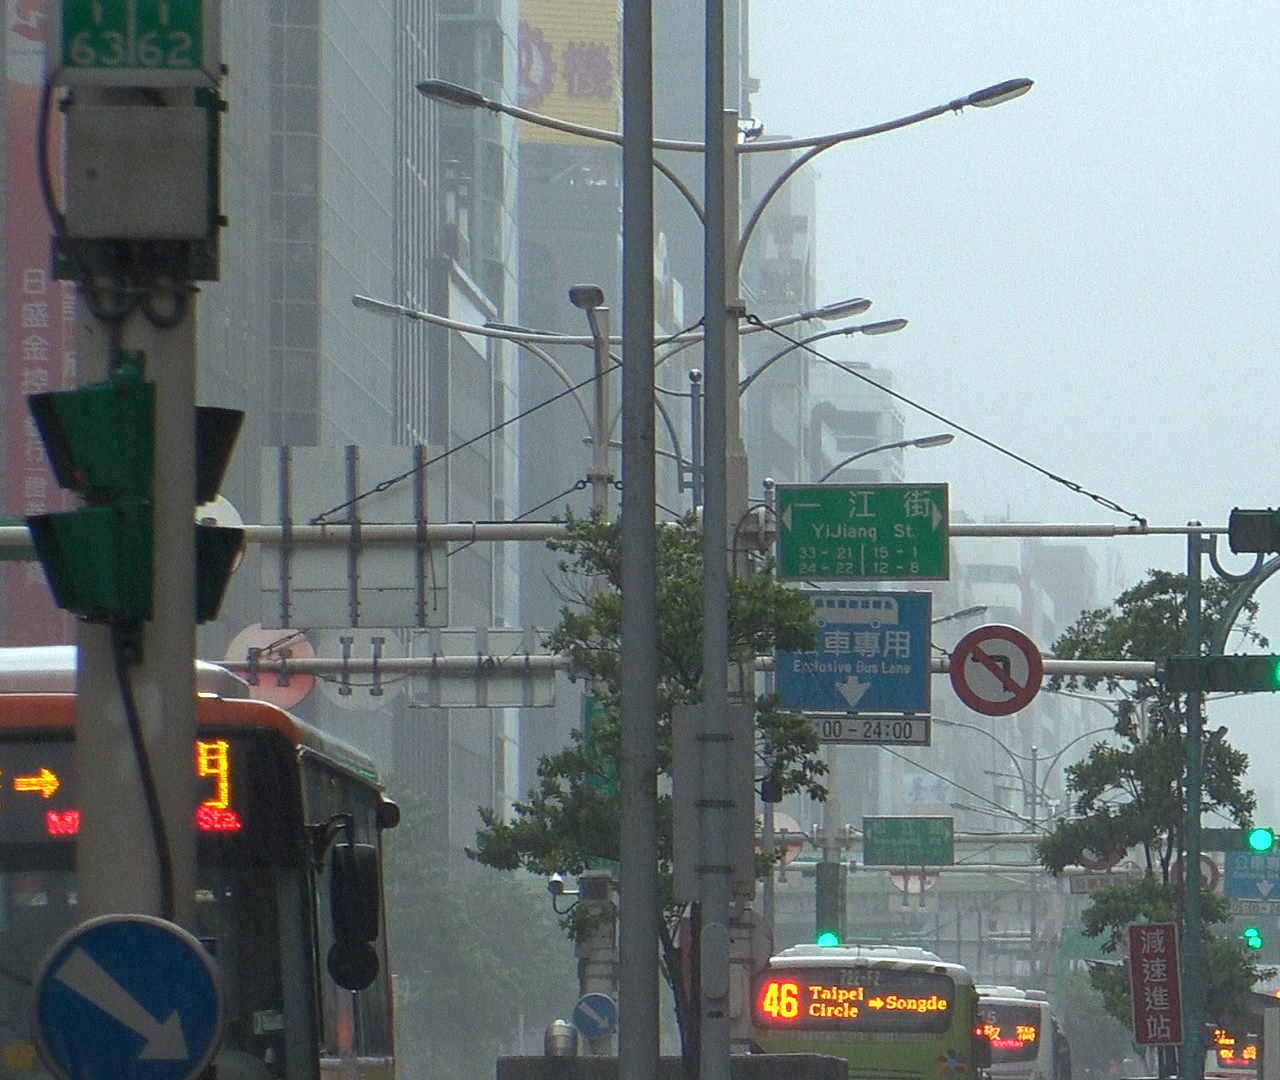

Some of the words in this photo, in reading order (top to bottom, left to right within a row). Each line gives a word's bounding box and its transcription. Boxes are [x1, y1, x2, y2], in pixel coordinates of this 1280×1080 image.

[70, 30, 124, 66] 63
[137, 31, 193, 66] 62
[793, 490, 931, 518] 一江街
[812, 524, 878, 542] YiJiang
[794, 631, 911, 659] 車專用
[793, 660, 851, 674] Exclusive
[856, 660, 878, 674] Bus
[881, 661, 911, 674] Lane
[863, 720, 913, 739] 24:00
[1141, 928, 1171, 1040] 減速進站
[763, 982, 799, 1019] 46
[809, 985, 864, 1003] Taipei
[808, 1002, 860, 1018] Circle
[885, 996, 948, 1013] Songde
